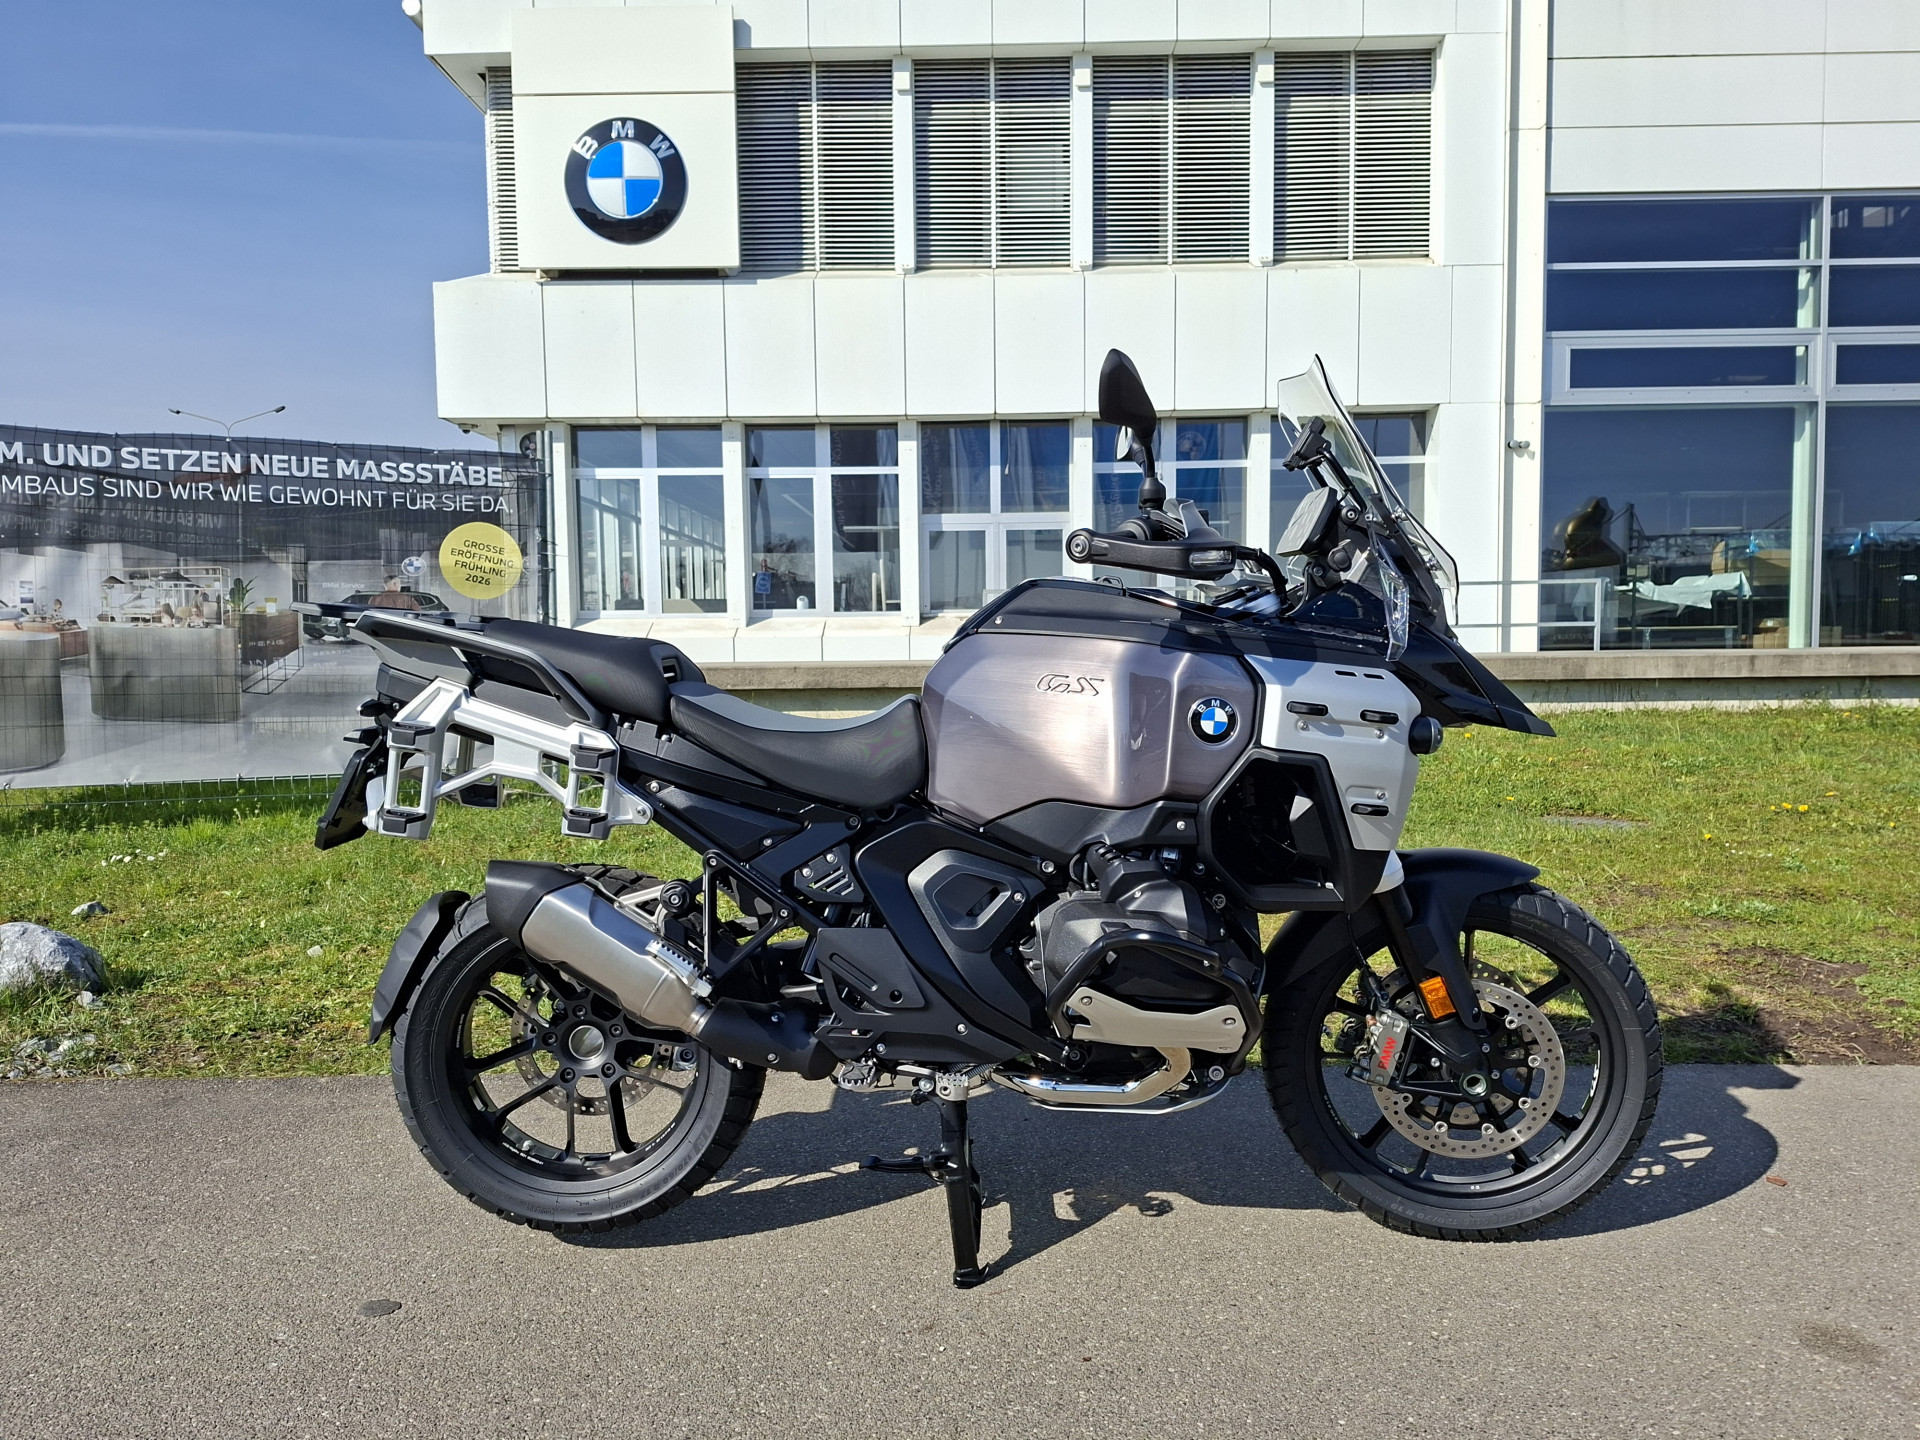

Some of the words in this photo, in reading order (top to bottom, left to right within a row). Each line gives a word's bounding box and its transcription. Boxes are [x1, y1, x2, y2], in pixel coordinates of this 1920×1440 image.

[572, 119, 675, 160] BMW
[43, 443, 112, 467] UND
[120, 447, 241, 474] SETZEN
[250, 453, 330, 479] NEUE
[336, 458, 510, 487] MASSSTÄBE.
[1, 475, 95, 497] MBAUS
[103, 478, 162, 499] SIND
[169, 481, 214, 501] WIR
[220, 483, 263, 503] WIE
[269, 485, 387, 508] GEWOHNT
[392, 489, 436, 511] FÜR
[442, 494, 475, 512] SIE
[481, 496, 513, 514] DA.
[450, 547, 514, 568] ERÖFFNUNG
[463, 540, 505, 555] GROSSE
[454, 559, 507, 578] FRÜHLING
[465, 573, 491, 586] 2026
[1035, 673, 1104, 697] GS
[1196, 699, 1234, 716] BMW
[1377, 1036, 1397, 1070] BMW
